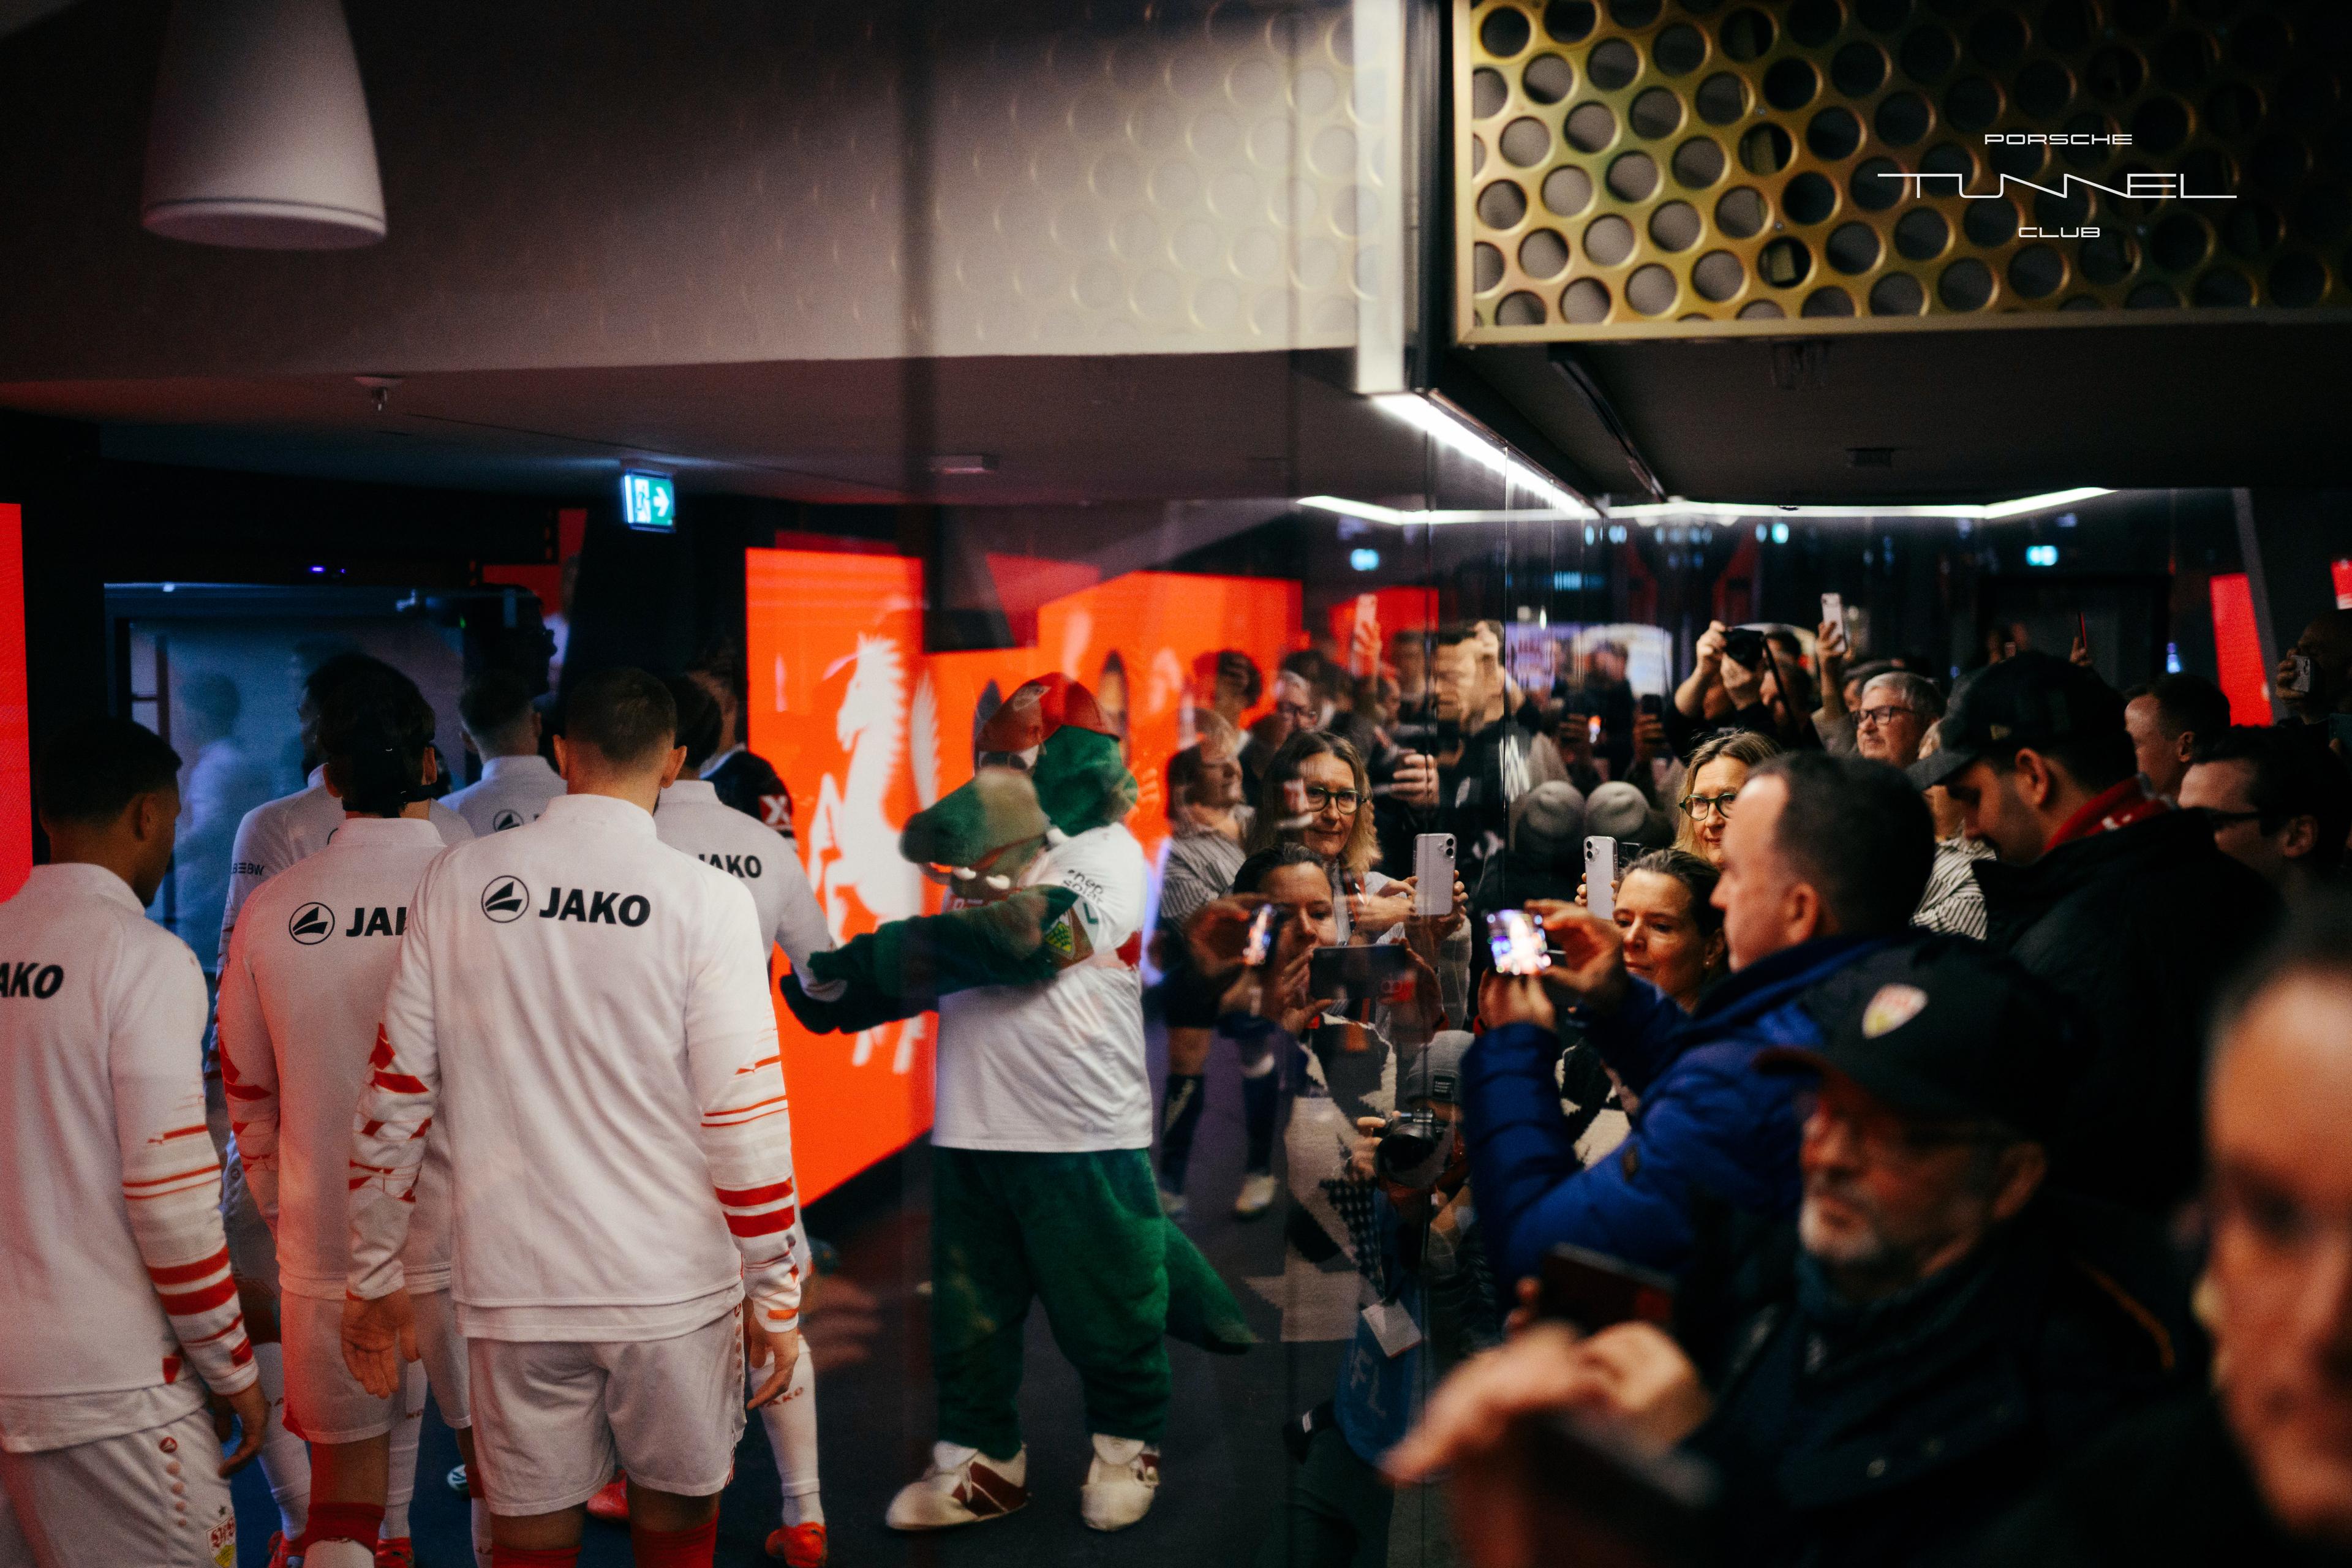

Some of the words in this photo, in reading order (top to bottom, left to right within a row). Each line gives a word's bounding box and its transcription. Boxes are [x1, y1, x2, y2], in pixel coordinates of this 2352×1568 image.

[698, 854, 762, 878] AKO
[538, 886, 651, 927] JAKO
[0, 962, 64, 999] AKO
